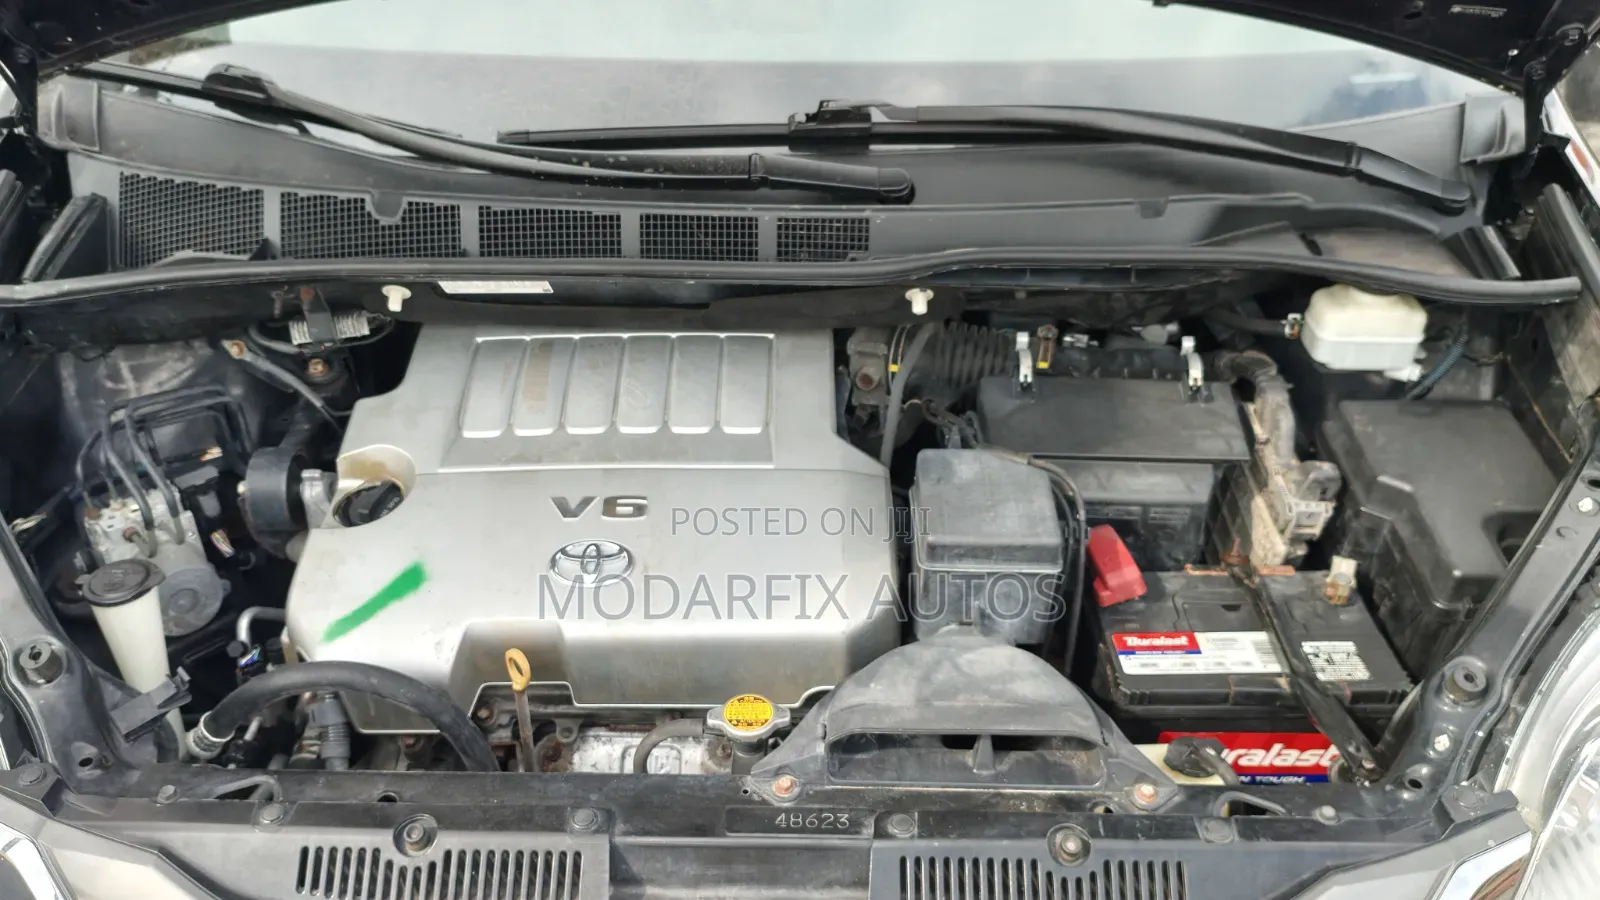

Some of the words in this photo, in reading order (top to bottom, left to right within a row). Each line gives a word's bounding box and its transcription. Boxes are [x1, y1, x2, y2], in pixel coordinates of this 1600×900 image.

[550, 495, 649, 520] V6
[1123, 635, 1190, 647] Duralast
[775, 812, 850, 829] 48623
